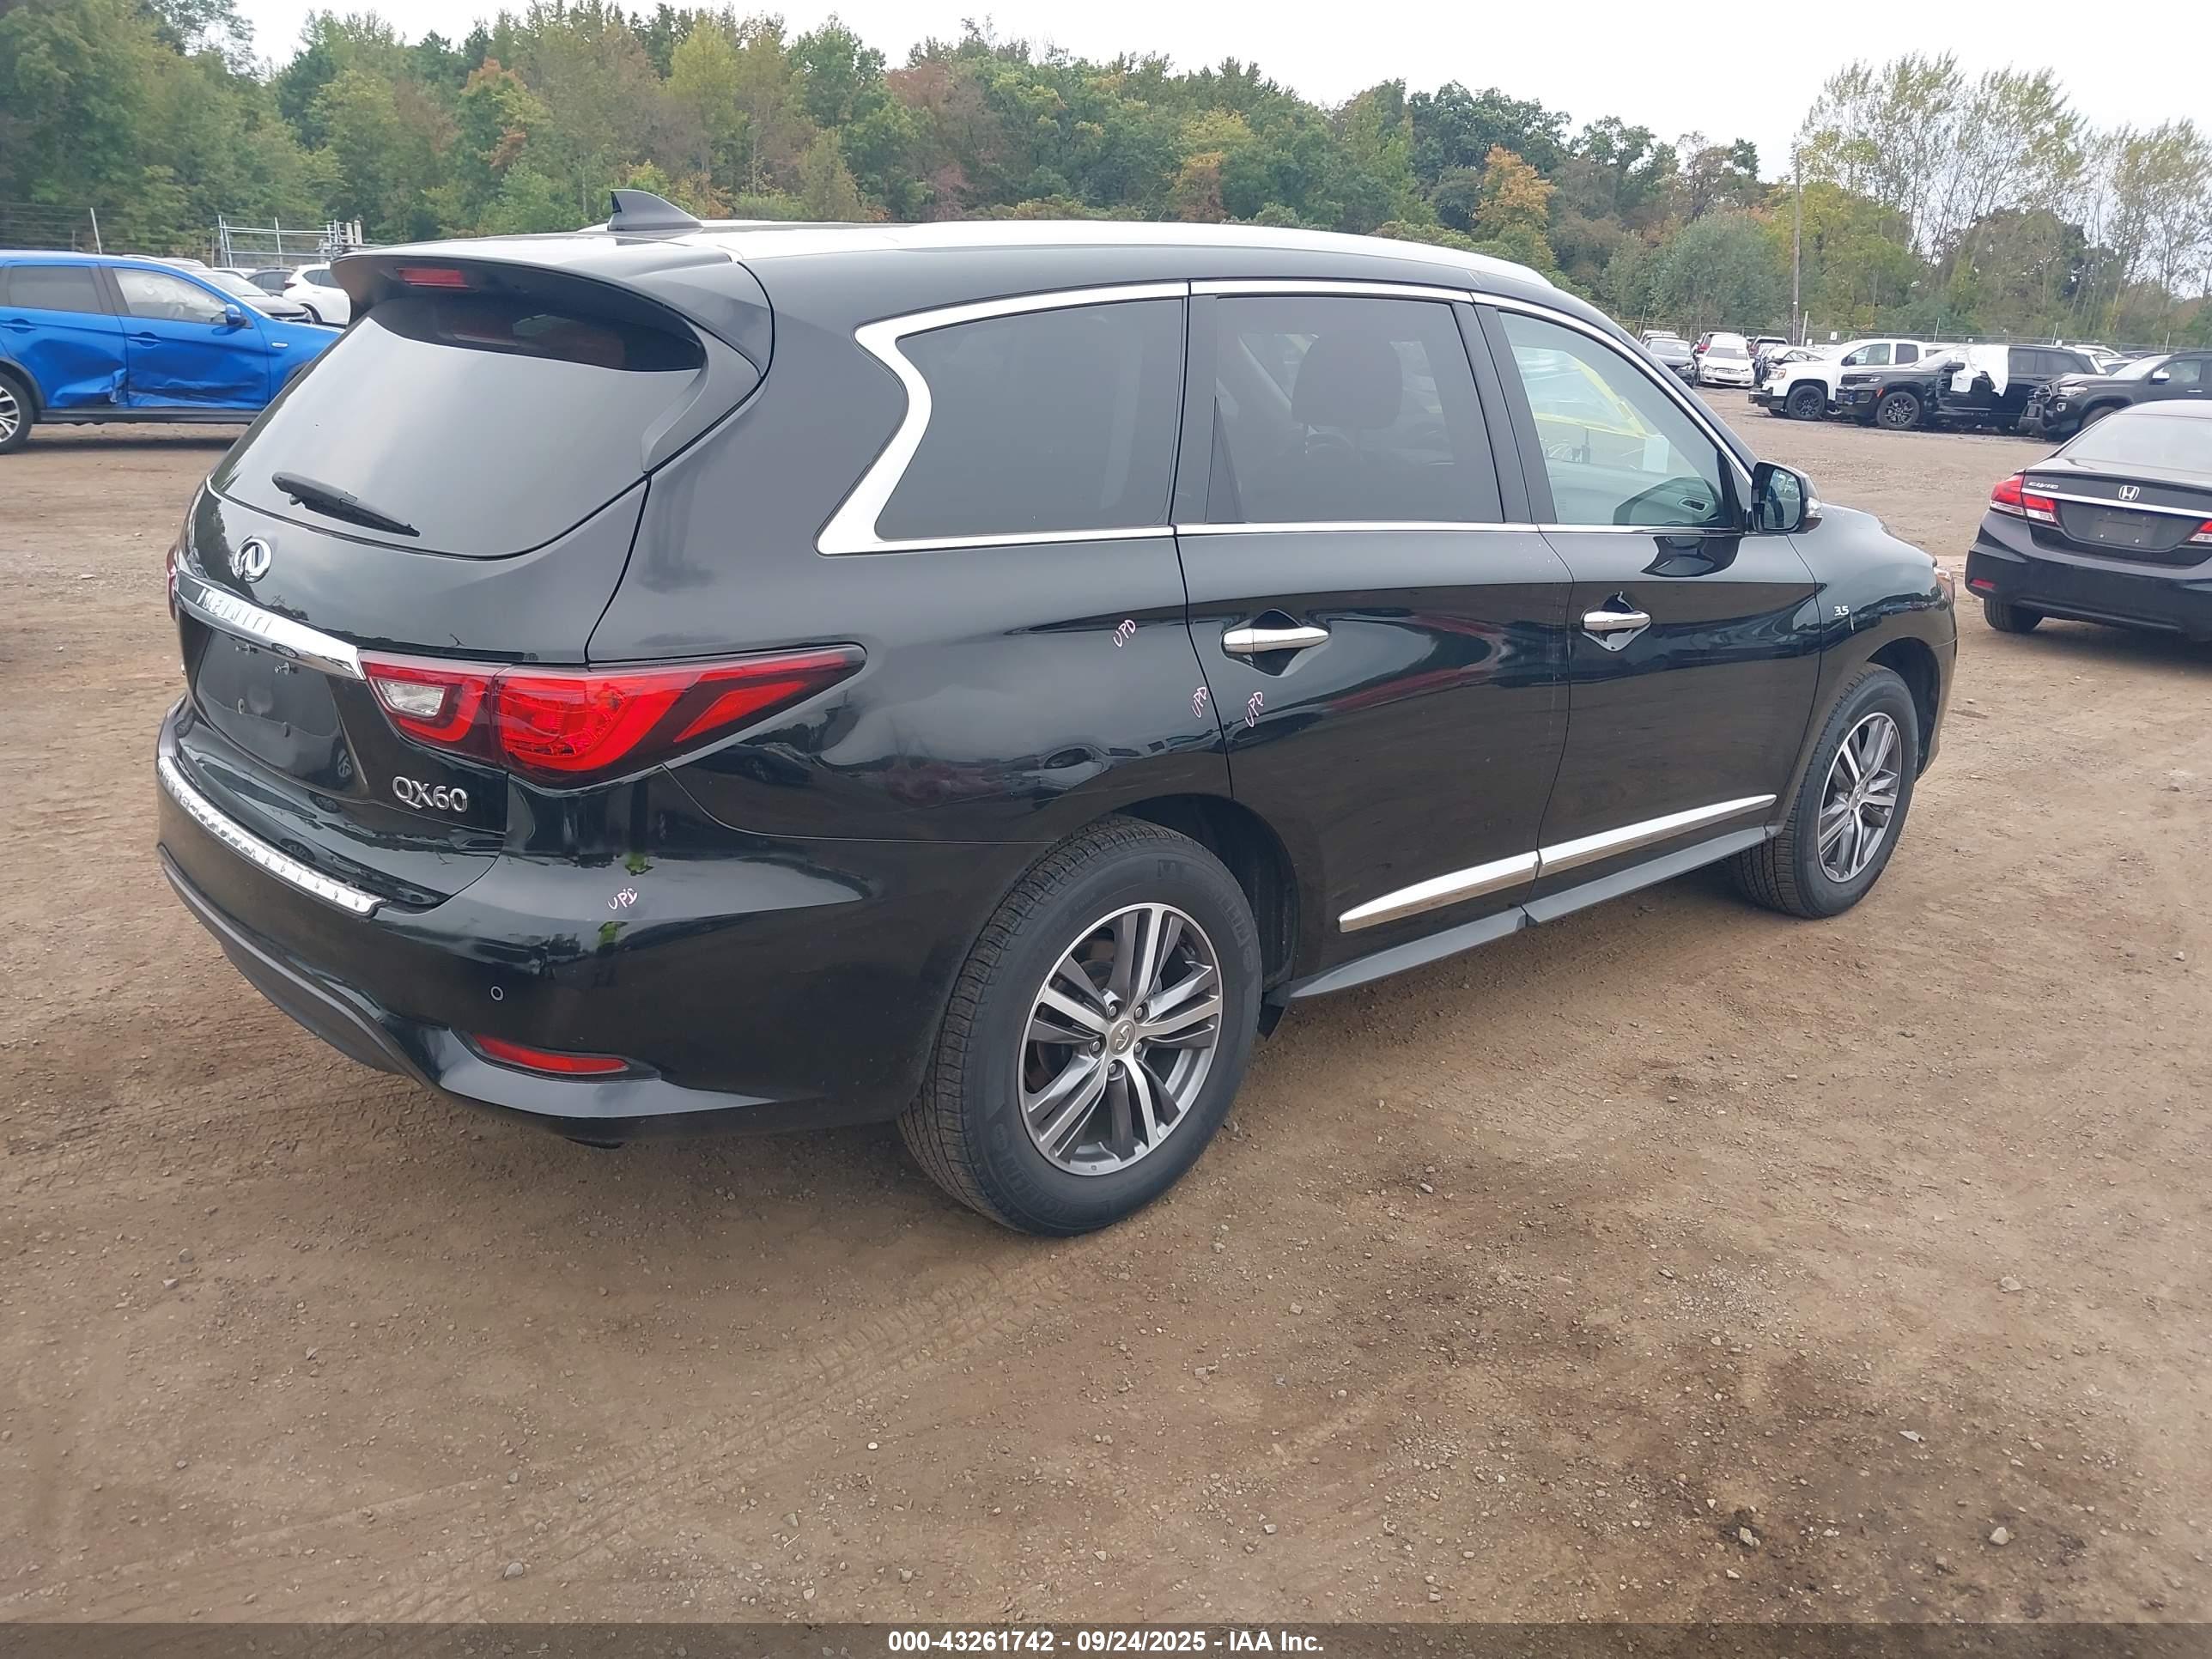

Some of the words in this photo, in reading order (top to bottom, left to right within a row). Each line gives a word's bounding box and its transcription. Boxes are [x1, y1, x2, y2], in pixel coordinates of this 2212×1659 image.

[1113, 619, 1136, 647] UPD
[1191, 686, 1207, 718] UPD
[1244, 691, 1264, 728] UPD
[392, 775, 468, 813] QX60
